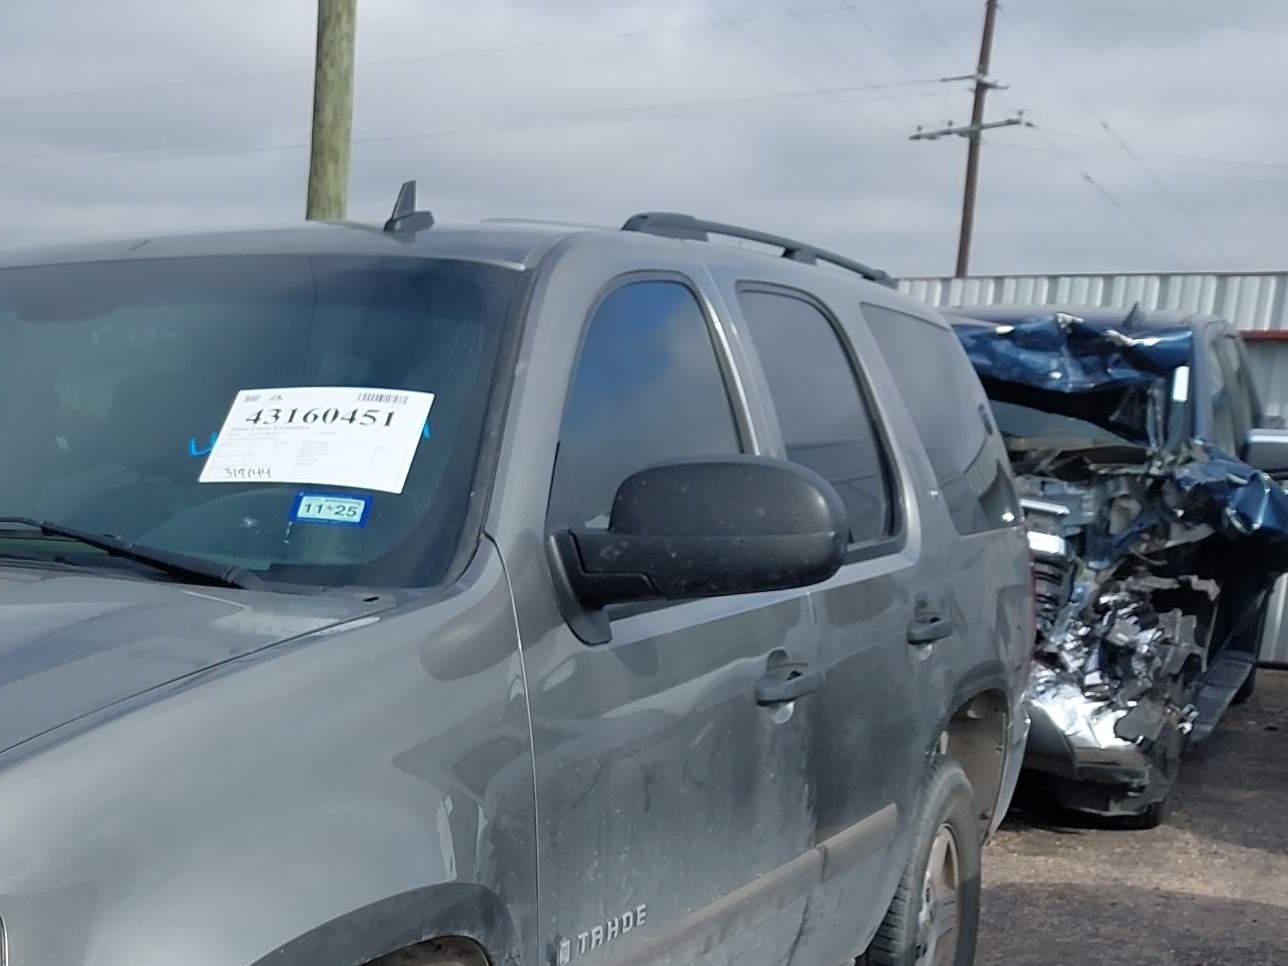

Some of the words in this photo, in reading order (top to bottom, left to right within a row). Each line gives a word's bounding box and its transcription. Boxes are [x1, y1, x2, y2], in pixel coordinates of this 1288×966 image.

[246, 407, 396, 428] 43160451
[334, 504, 359, 518] 25
[576, 903, 647, 955] TAHOE
